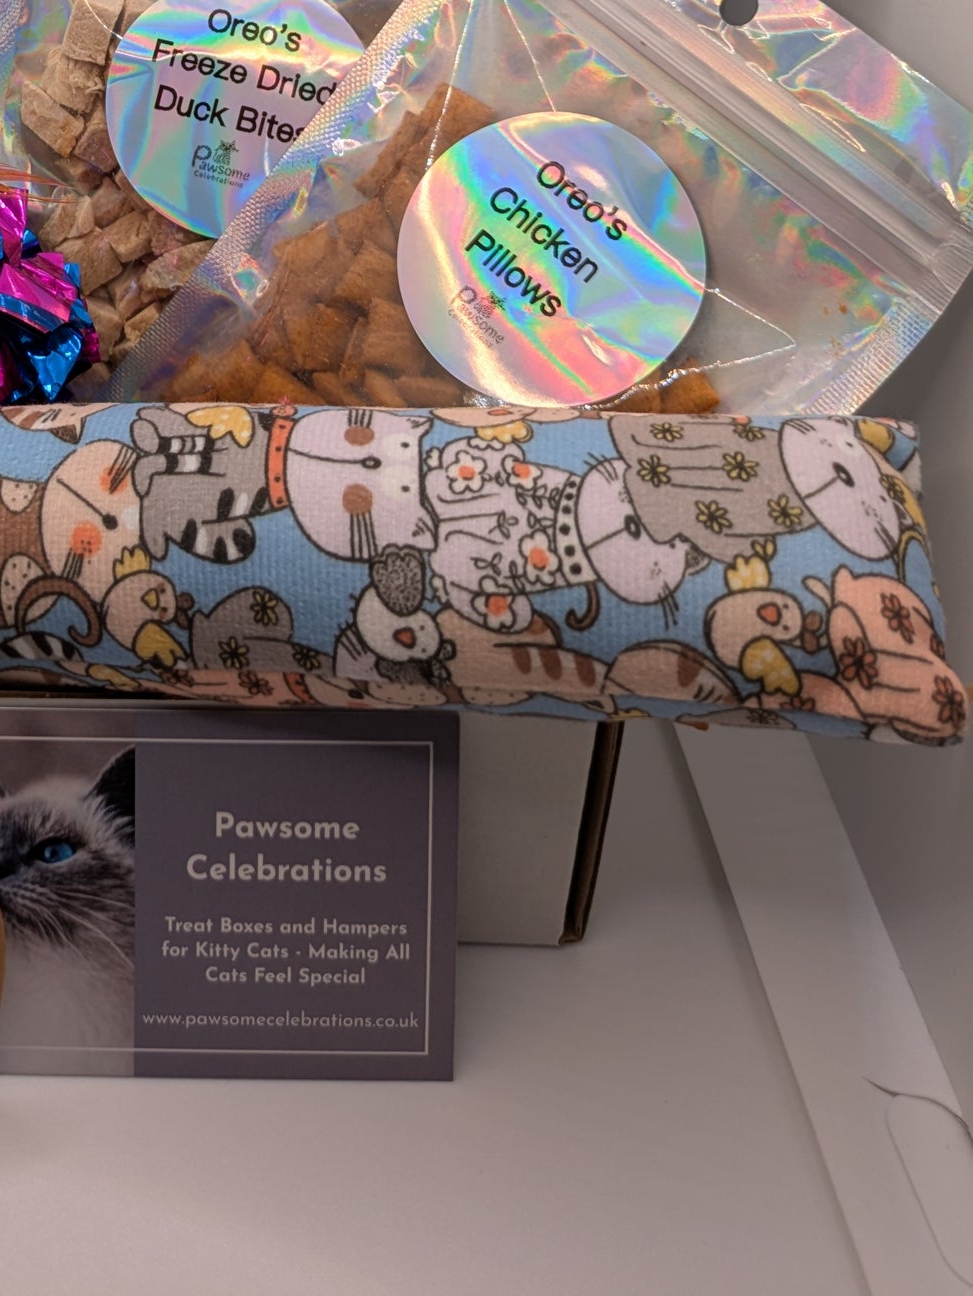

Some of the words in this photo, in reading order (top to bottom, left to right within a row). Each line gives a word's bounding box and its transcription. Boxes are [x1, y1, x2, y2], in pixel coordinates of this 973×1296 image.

[208, 8, 302, 52] Oreo's
[151, 38, 248, 84] Freeze
[257, 64, 337, 106] Dried
[154, 84, 229, 128] Duck
[191, 145, 251, 181] Pawsome
[536, 161, 627, 241] Oreo's
[489, 187, 599, 283] Chicken
[464, 229, 562, 317] Pillows
[215, 811, 360, 840] Pawsome
[186, 853, 387, 882] Celebrations
[165, 916, 213, 933] Treat
[220, 917, 273, 934] Boxes
[279, 917, 315, 935] and
[323, 918, 408, 939] Hampers
[162, 940, 188, 957] for
[196, 941, 241, 961] Kitty
[247, 942, 289, 959] Cats
[308, 943, 379, 963] Making
[385, 943, 410, 960] All
[205, 966, 247, 983] Cats
[254, 966, 292, 983] Feel
[299, 968, 365, 987] Special
[142, 1010, 419, 1028] www.pawsomecelebrations.co.uk
